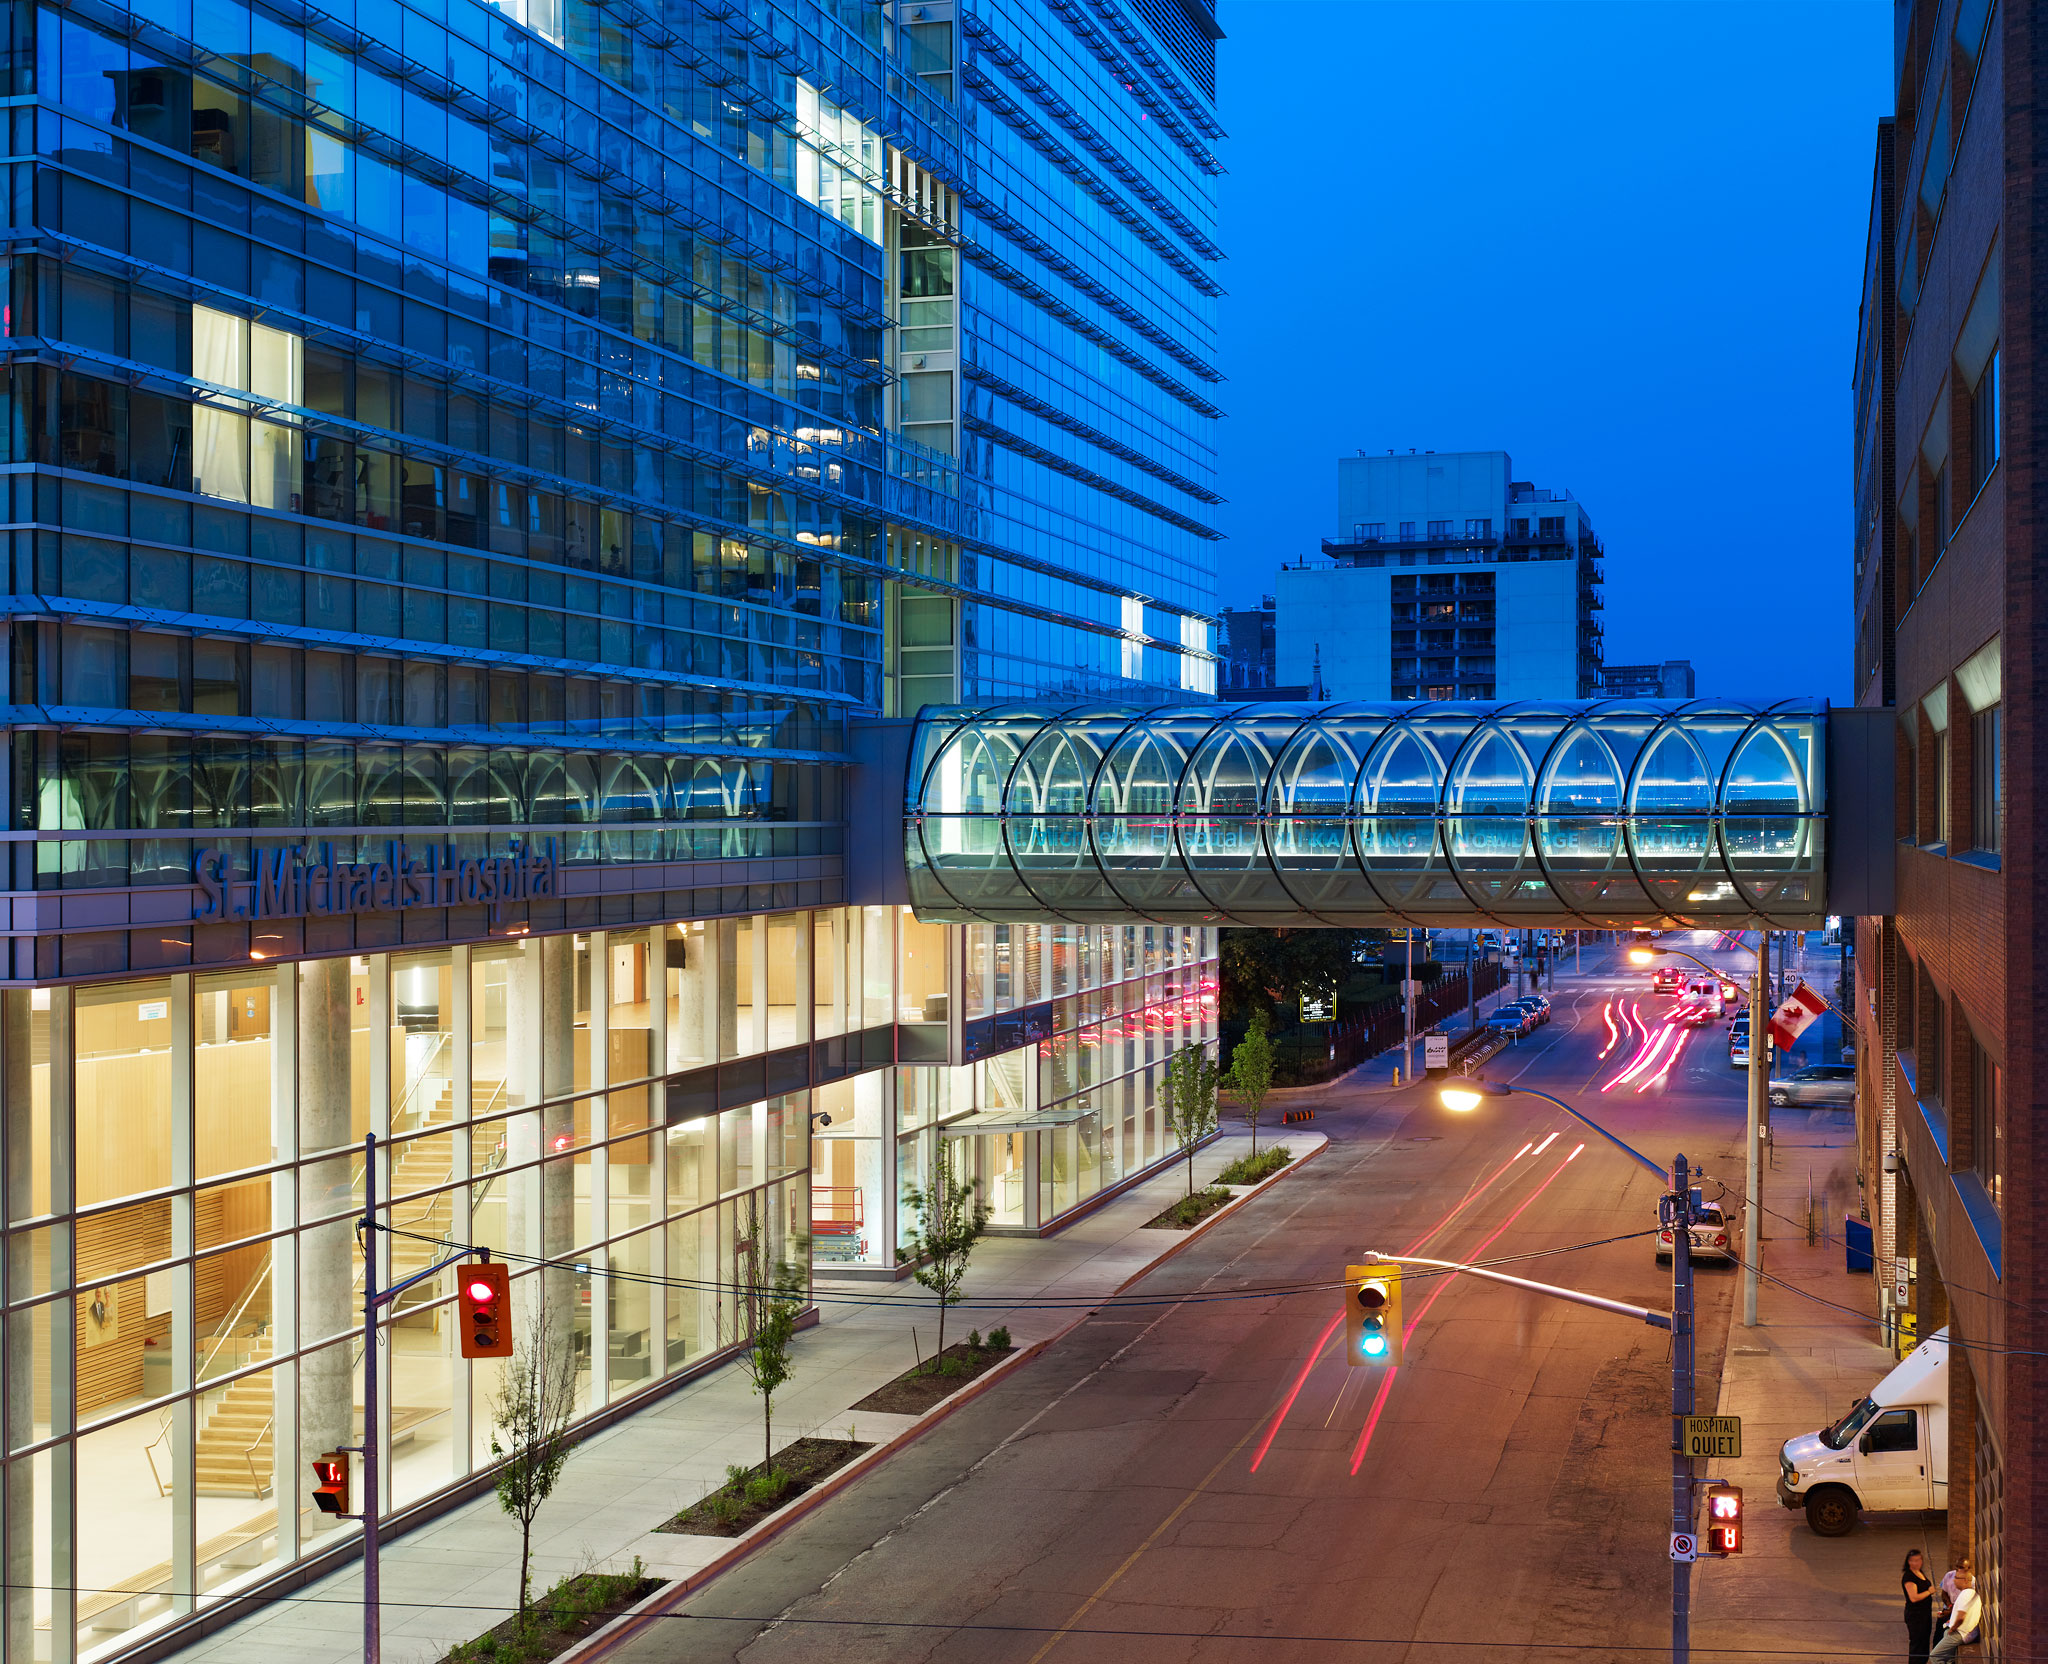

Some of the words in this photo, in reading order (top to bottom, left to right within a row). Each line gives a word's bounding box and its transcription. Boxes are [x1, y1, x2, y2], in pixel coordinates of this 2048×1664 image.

[1031, 825, 1132, 848] Michel's
[1151, 825, 1243, 853] Hspital
[1348, 831, 1416, 848] HING
[1445, 831, 1578, 848] NOWLDGE
[1598, 831, 1711, 848] INTITUTE
[194, 848, 250, 924] St.
[253, 839, 425, 920] Michael's
[433, 837, 559, 923] Hospital
[1785, 974, 1796, 983] 40
[1690, 1419, 1735, 1433] HOSPITAL
[1692, 1436, 1734, 1455] QUIET
